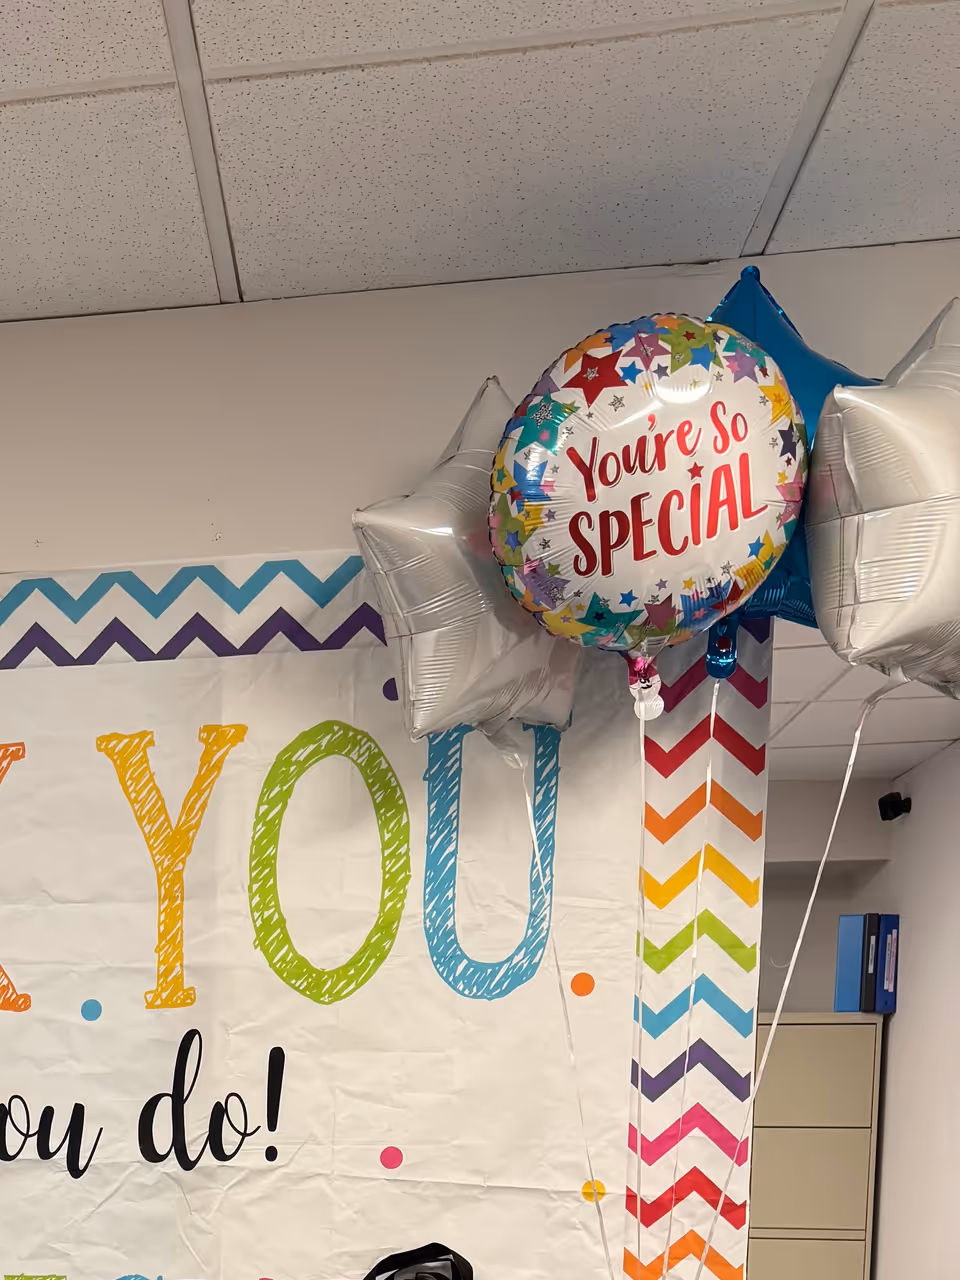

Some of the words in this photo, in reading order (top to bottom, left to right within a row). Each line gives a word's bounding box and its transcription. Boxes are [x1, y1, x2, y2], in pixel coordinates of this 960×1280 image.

[567, 413, 702, 502] You're
[711, 400, 749, 456] So
[96, 720, 561, 1008] YOU
[138, 1029, 285, 1171] do!
